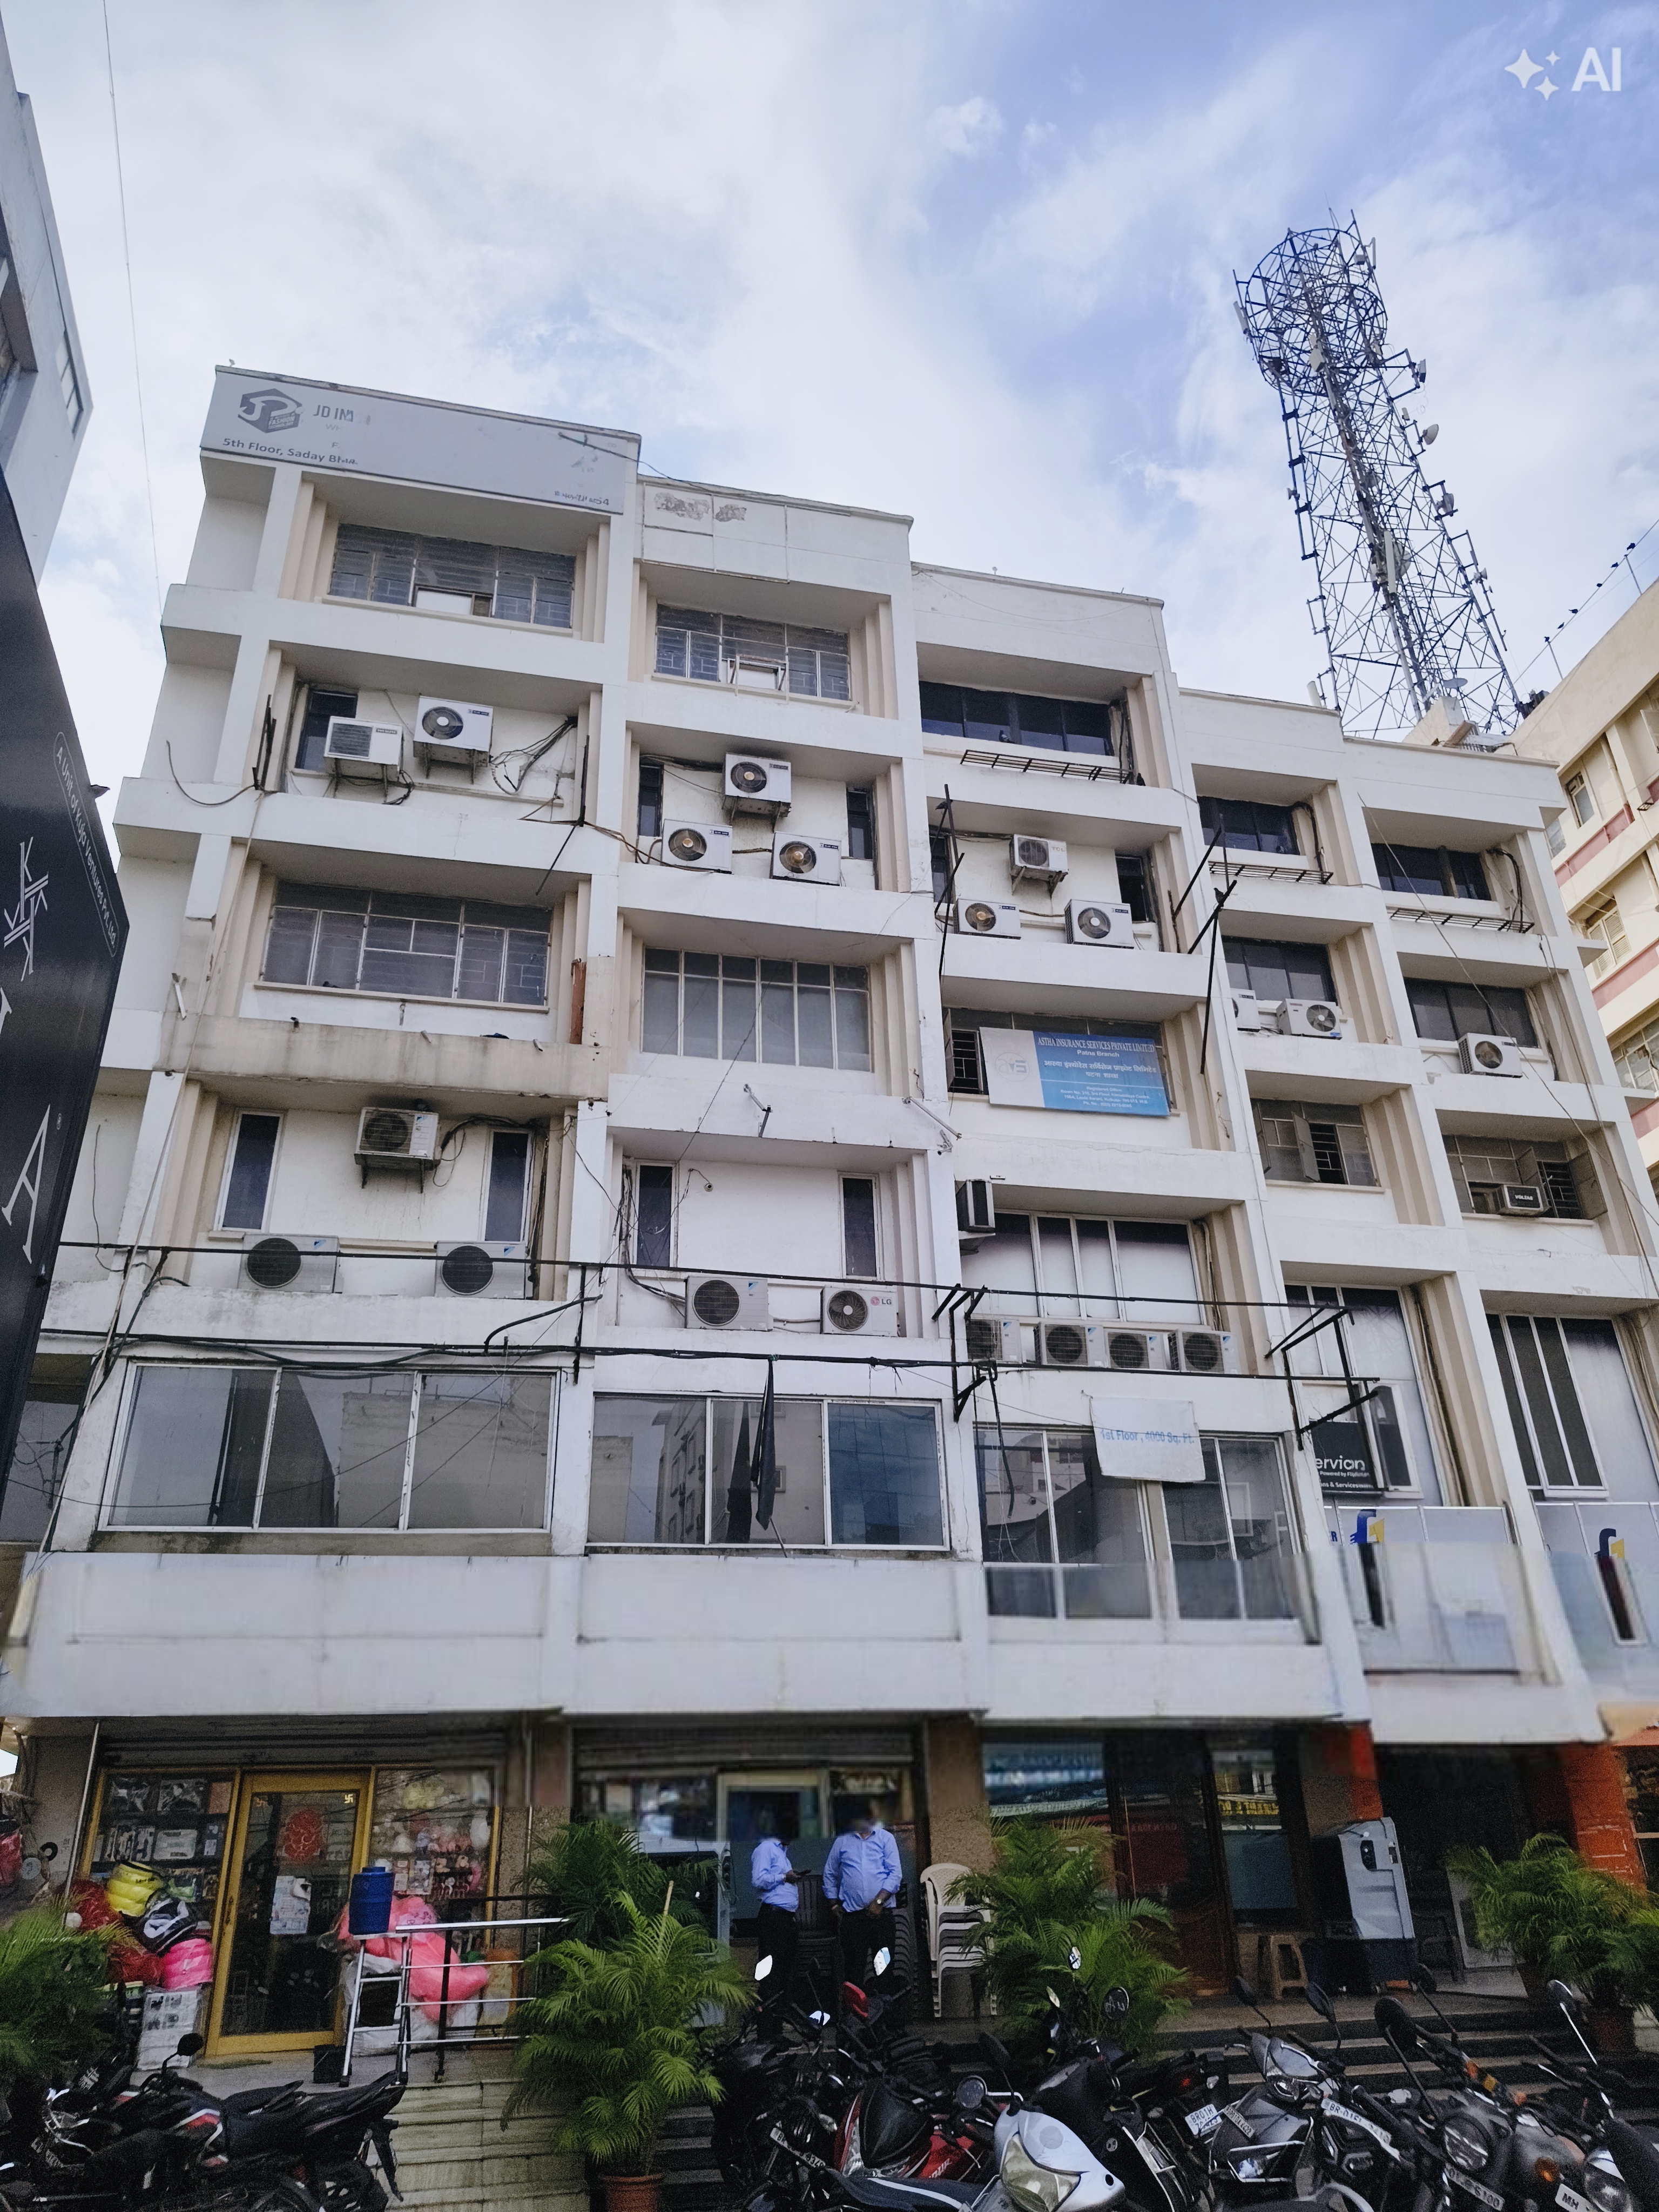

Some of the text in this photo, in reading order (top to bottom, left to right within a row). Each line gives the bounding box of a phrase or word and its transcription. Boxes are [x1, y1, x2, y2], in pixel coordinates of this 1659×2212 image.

[222, 438, 244, 448] 5th
[248, 442, 283, 456] Floor,
[287, 448, 325, 462] Saday
[57, 746, 63, 764] A
[1038, 1037, 1155, 1053] ASTHA INSURANCE SERVICES PRIVATE LIMITED
[1101, 1428, 1114, 1440] 1st
[1190, 2106, 1213, 2123] BR01H
